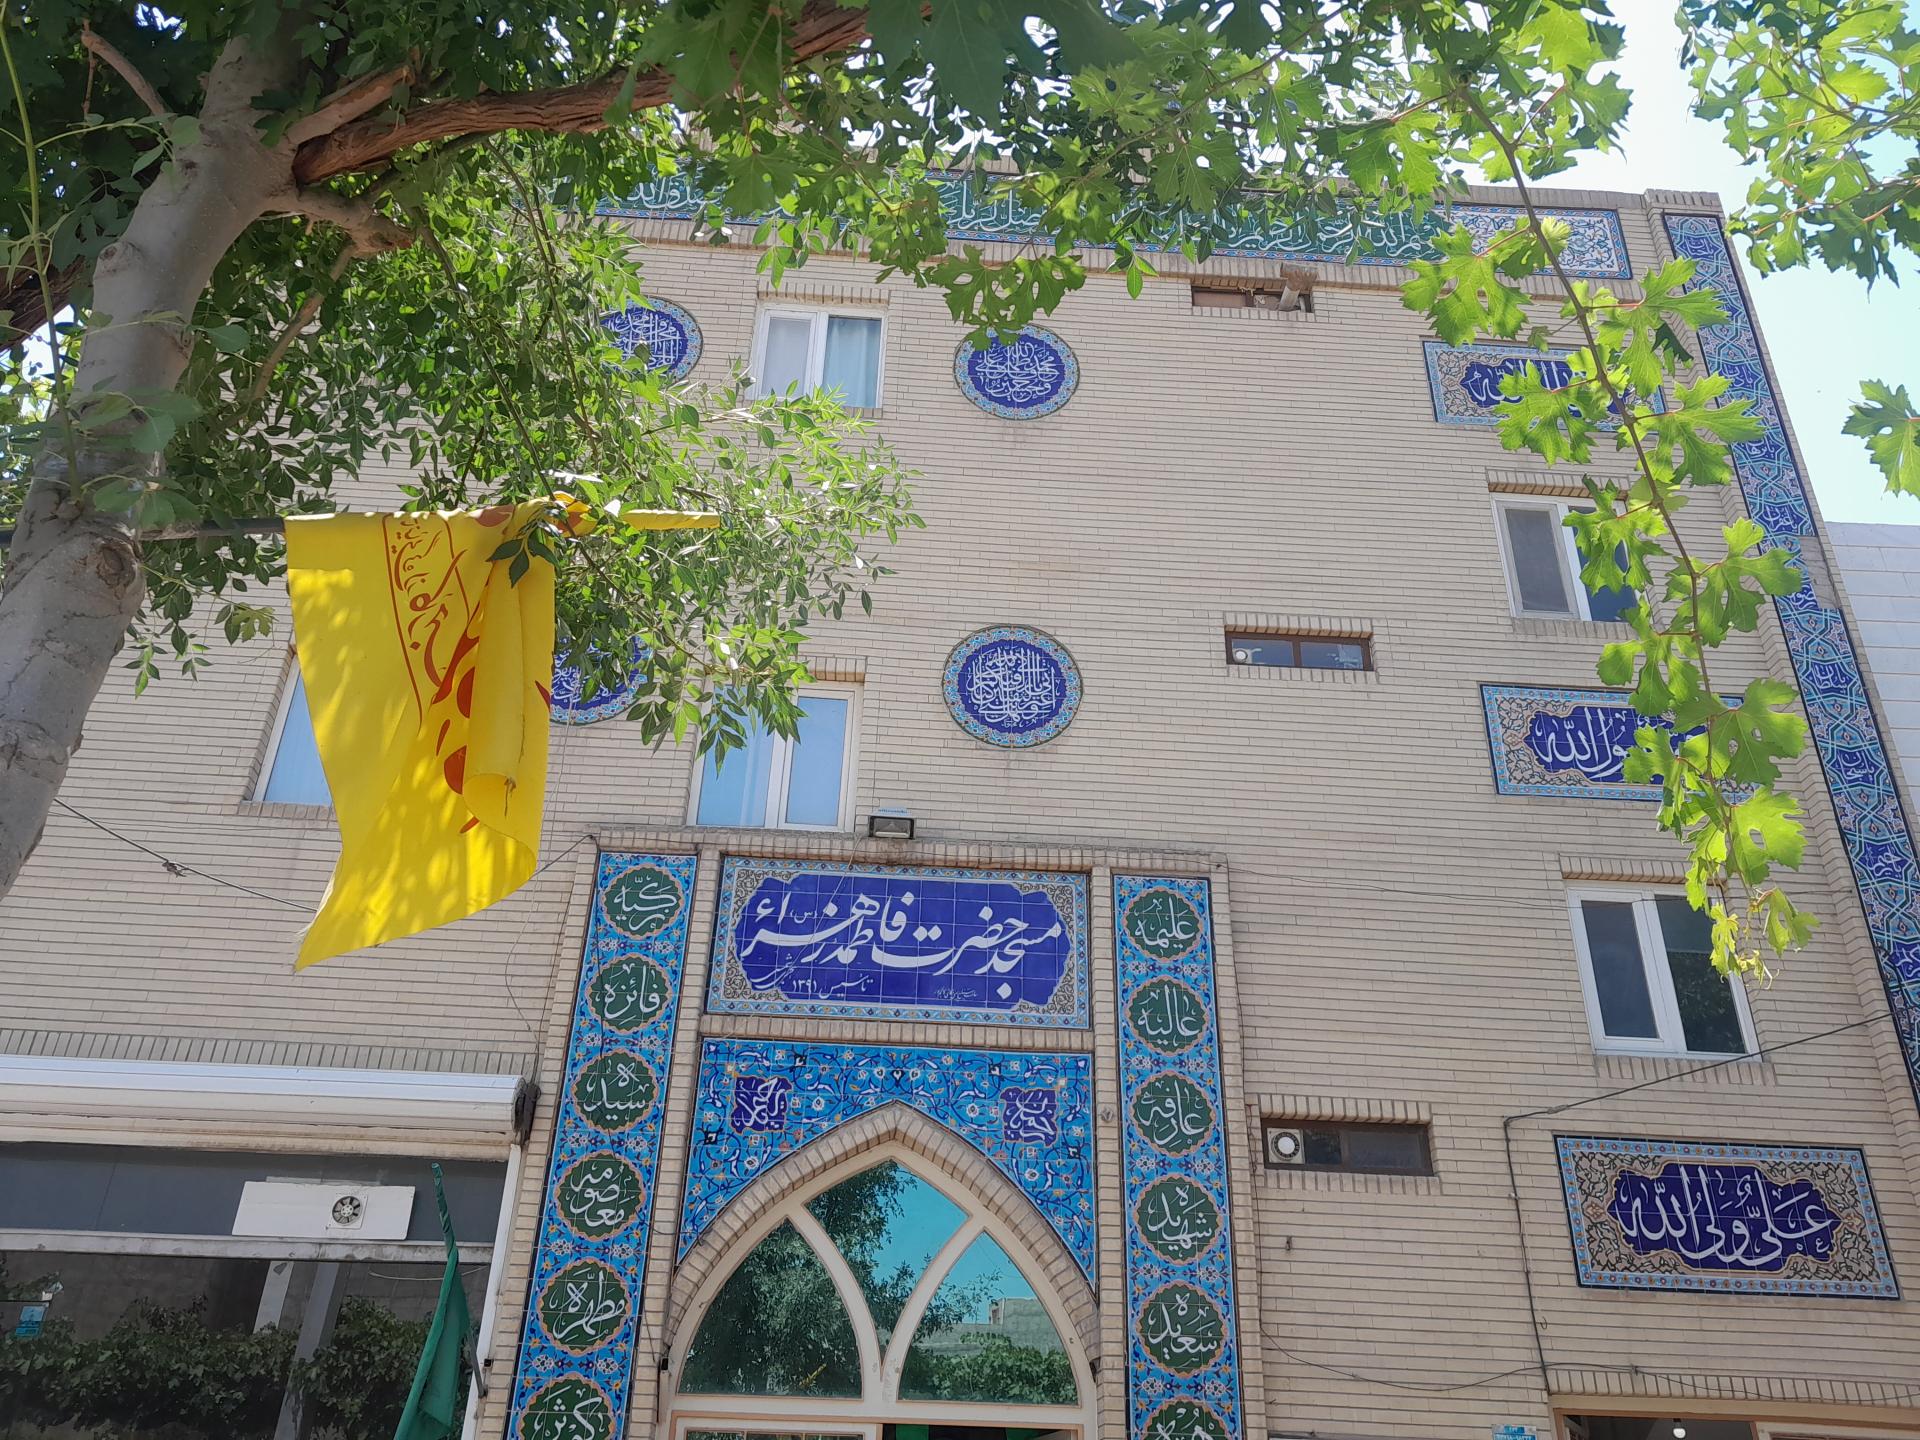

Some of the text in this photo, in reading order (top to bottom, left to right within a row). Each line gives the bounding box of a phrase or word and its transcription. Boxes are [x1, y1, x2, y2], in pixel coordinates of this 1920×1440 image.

[1531, 706, 1598, 765] الله
[871, 904, 1030, 976] حضرت
[974, 921, 1063, 1000] مسجد
[1615, 1164, 1700, 1247] الله
